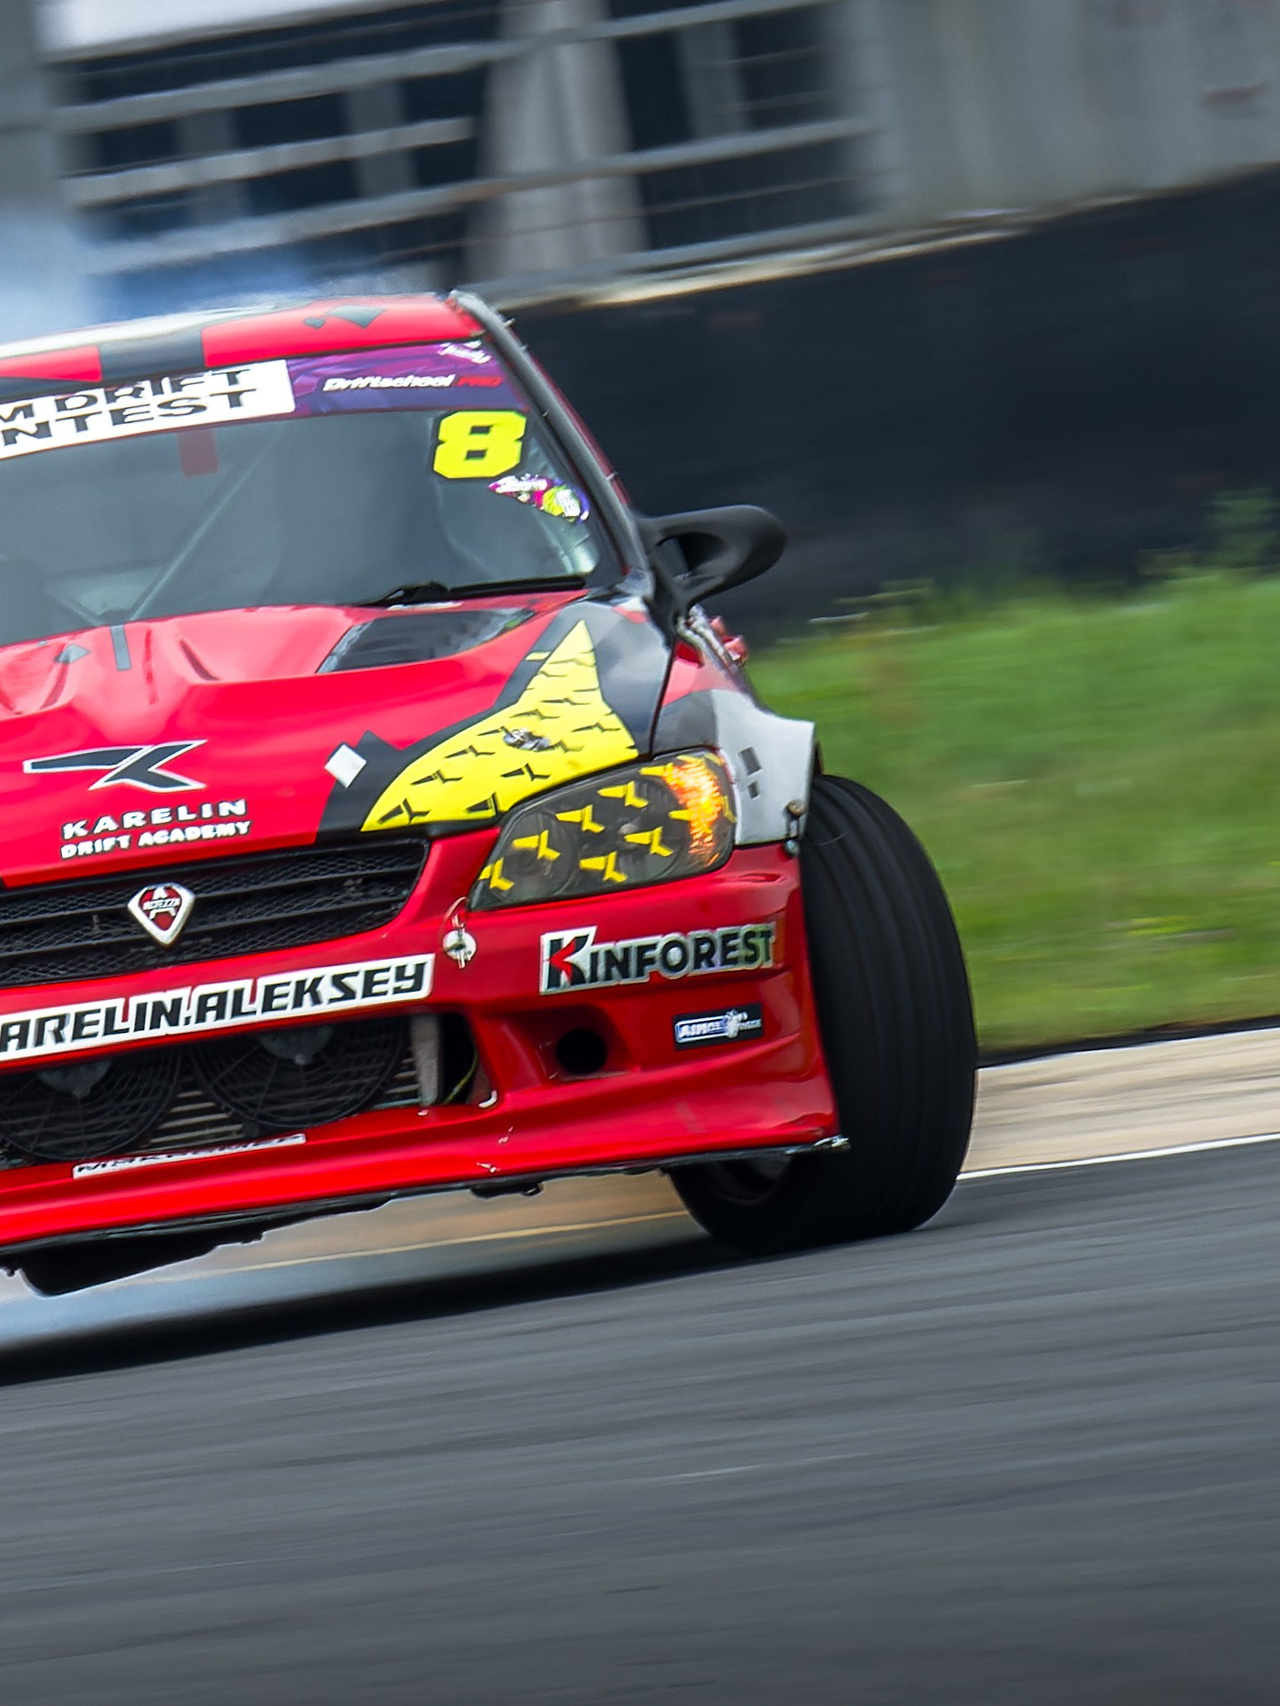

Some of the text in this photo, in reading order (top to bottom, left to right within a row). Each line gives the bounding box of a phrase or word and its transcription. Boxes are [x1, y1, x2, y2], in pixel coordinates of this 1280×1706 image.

[54, 367, 251, 413] DRIFT
[432, 410, 528, 479] 8
[60, 821, 252, 859] DRIFT ACADEMY
[62, 799, 247, 840] KARELIN
[546, 928, 776, 989] KINFOREST
